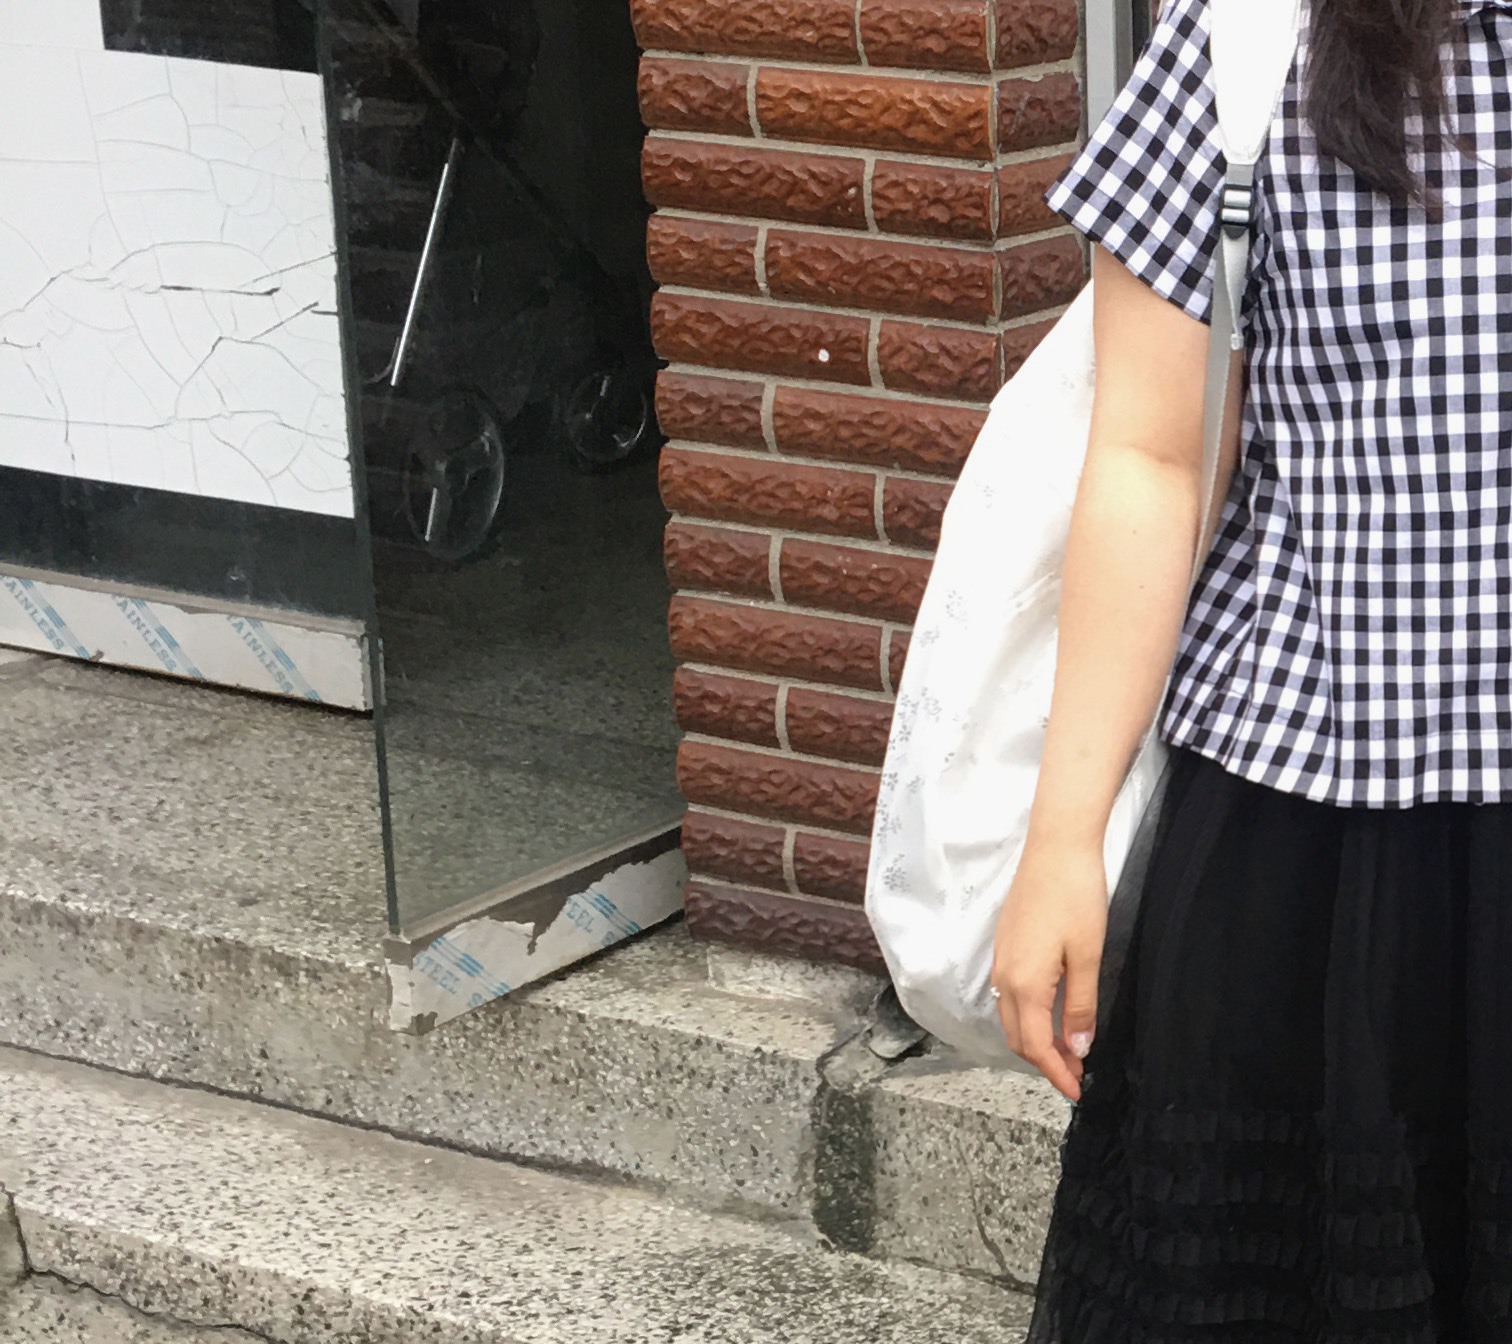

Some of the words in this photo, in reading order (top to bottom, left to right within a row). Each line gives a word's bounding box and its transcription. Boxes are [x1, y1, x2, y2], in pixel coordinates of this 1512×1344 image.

[2, 577, 65, 651] AINLESS
[112, 594, 178, 672] AINLESS
[227, 615, 295, 694] AINLESS
